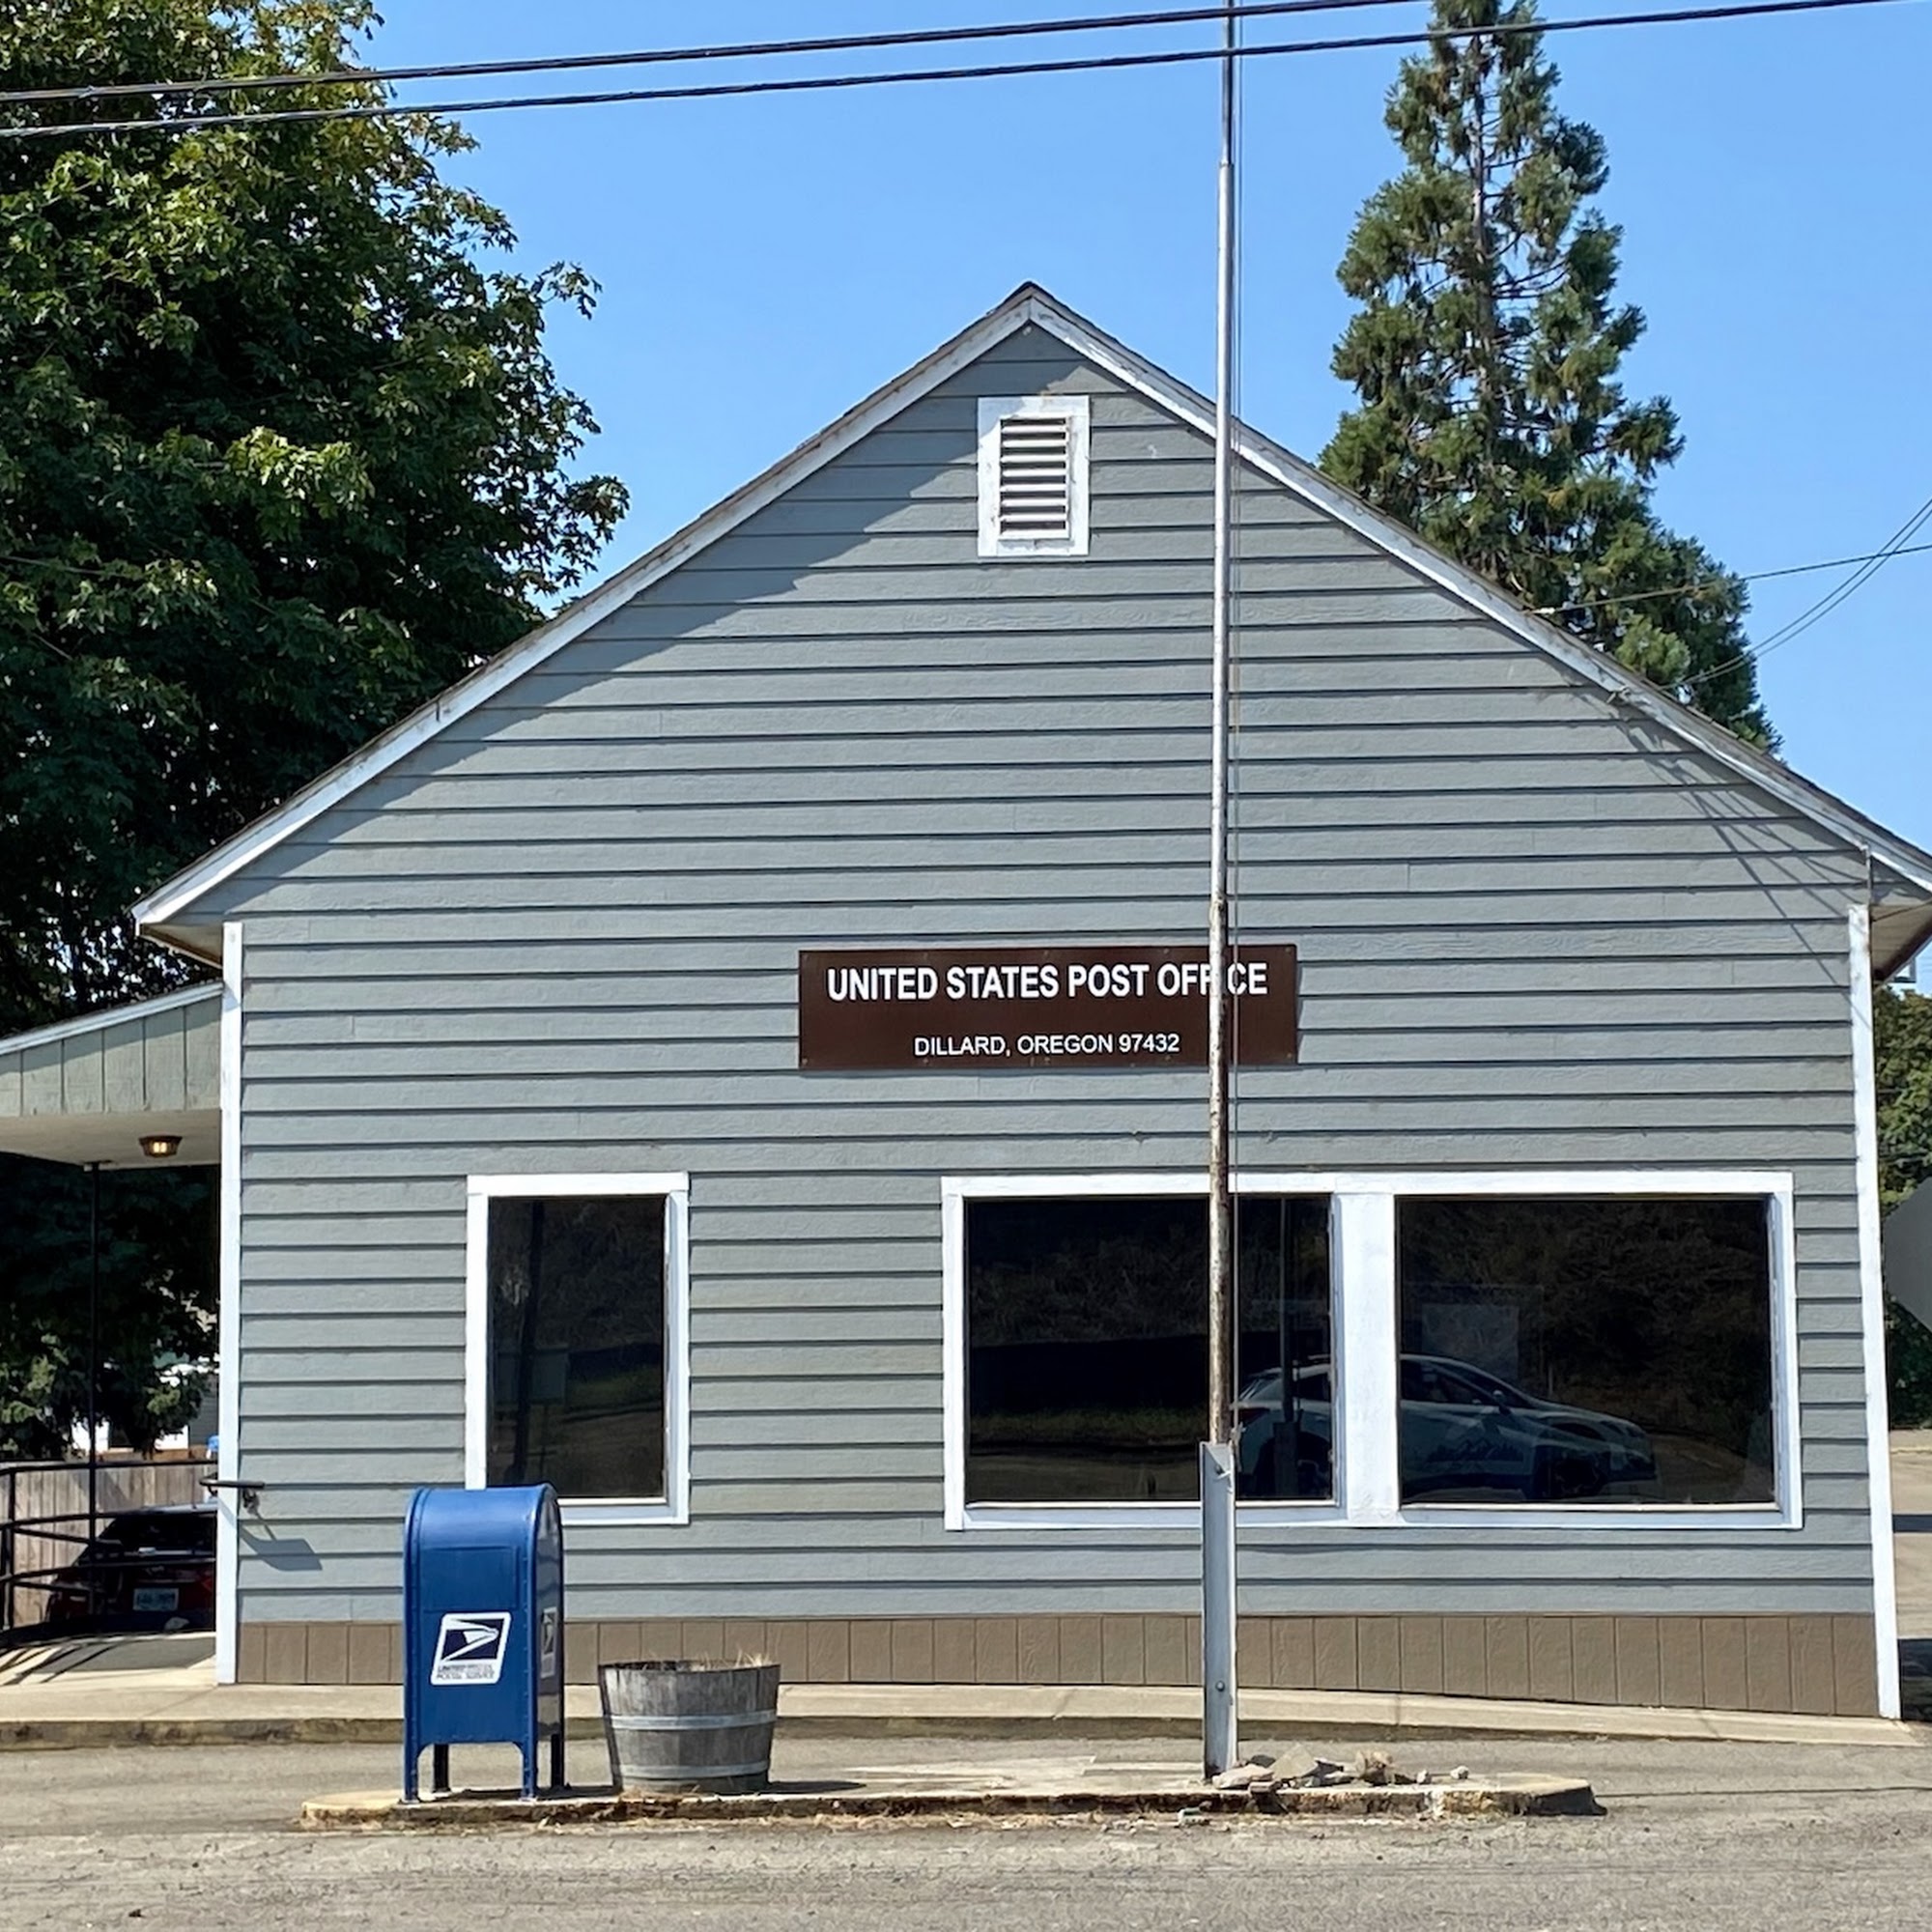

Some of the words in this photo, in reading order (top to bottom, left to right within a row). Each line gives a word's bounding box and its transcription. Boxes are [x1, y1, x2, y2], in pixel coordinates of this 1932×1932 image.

[827, 967, 938, 1000] UNITED
[946, 965, 1060, 999] STATES
[1067, 964, 1151, 997] POST
[1157, 962, 1268, 996] OFFCE
[914, 1036, 1010, 1057] DILLARD,
[1017, 1034, 1113, 1054] OREGON
[1119, 1033, 1179, 1053] 97432
